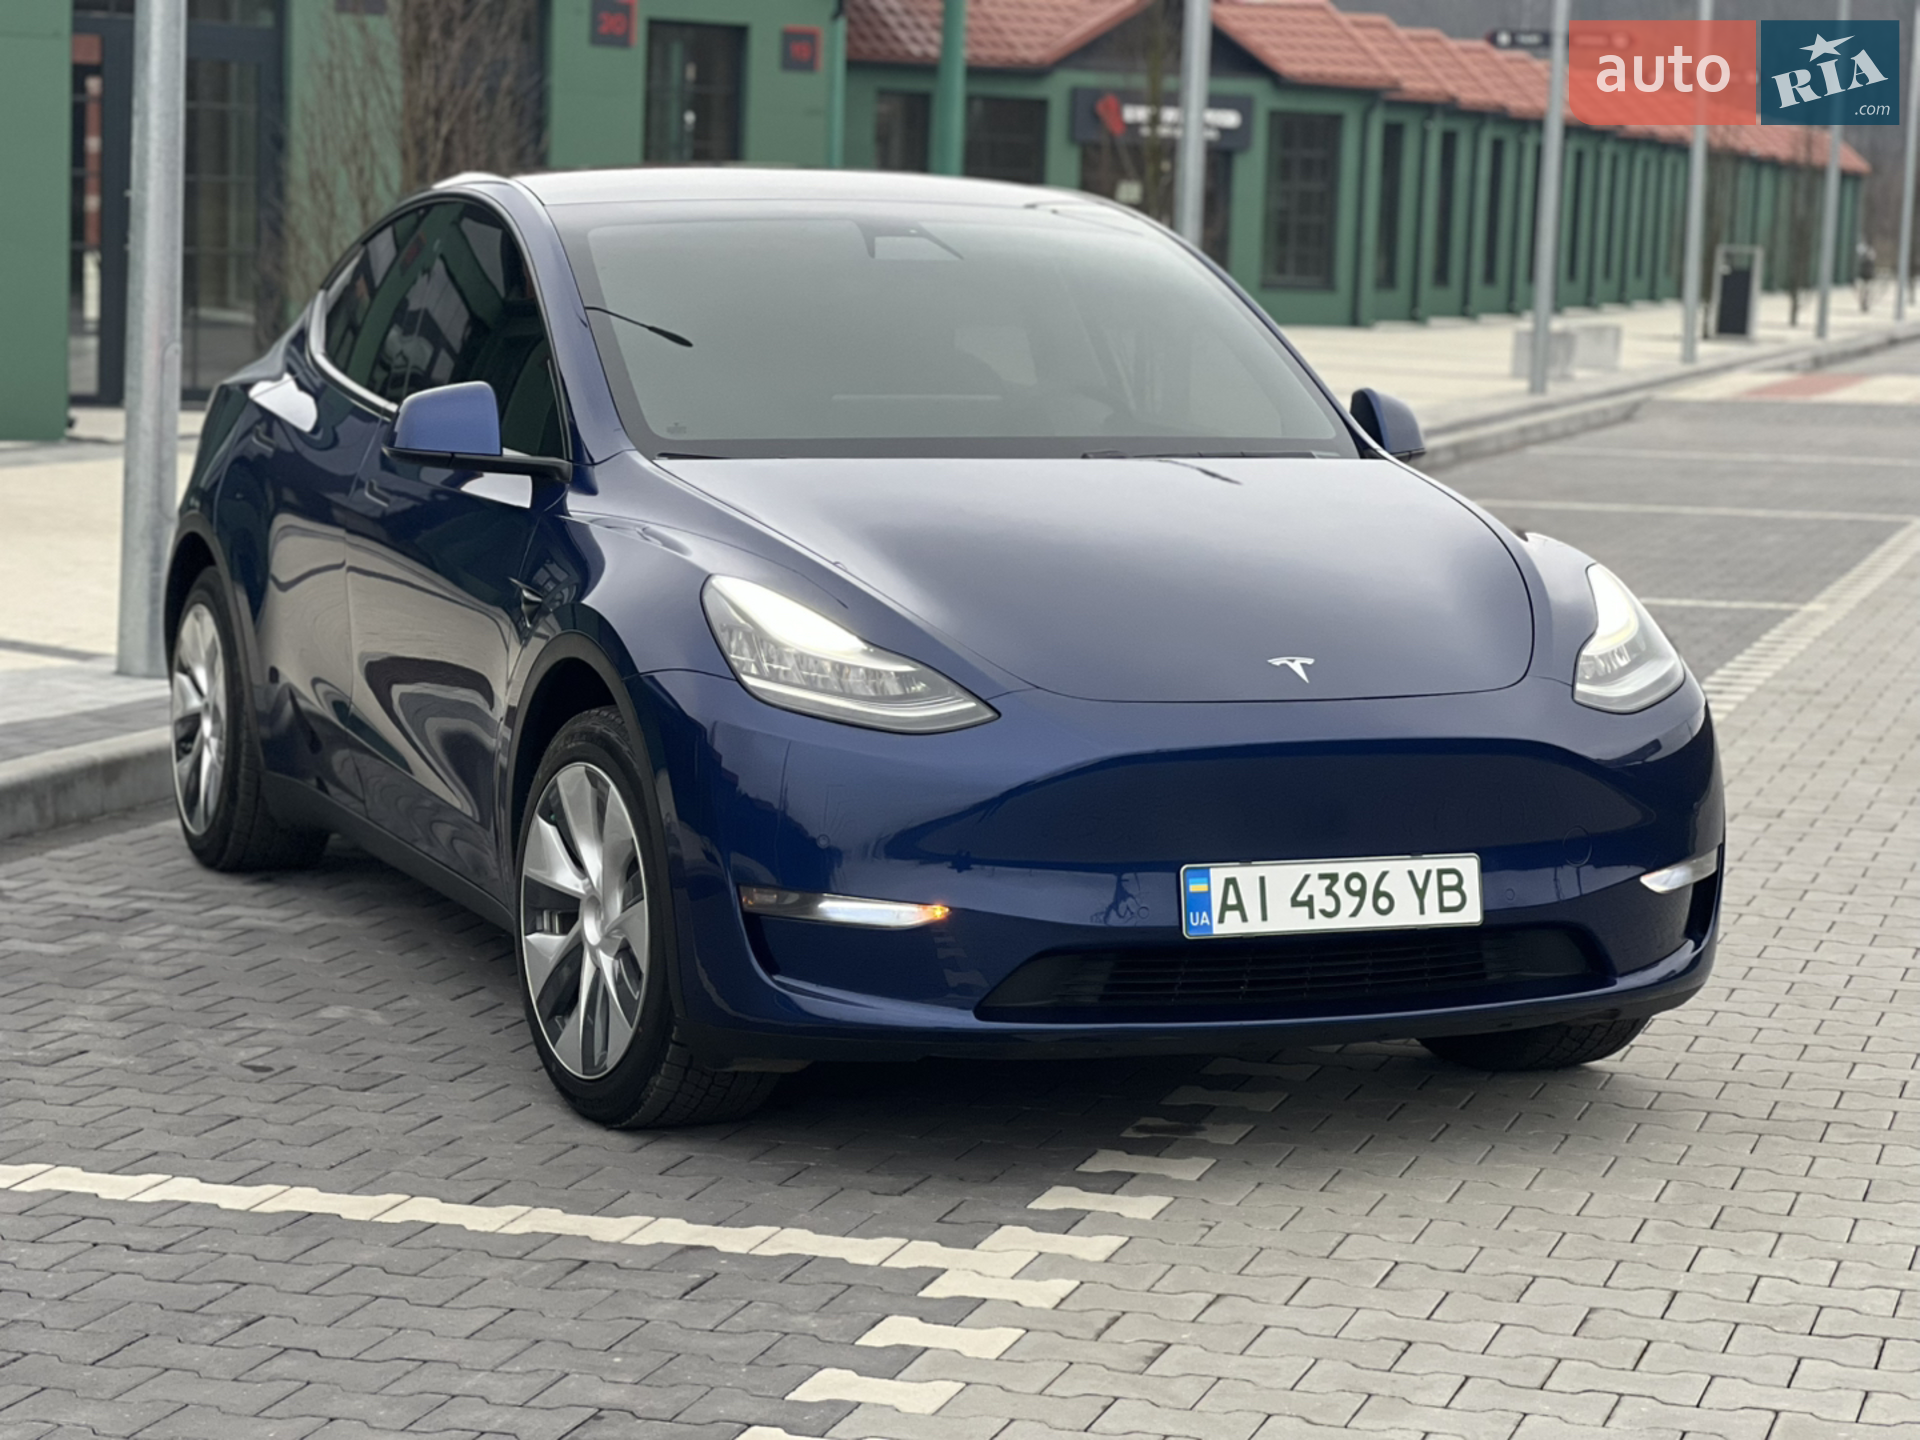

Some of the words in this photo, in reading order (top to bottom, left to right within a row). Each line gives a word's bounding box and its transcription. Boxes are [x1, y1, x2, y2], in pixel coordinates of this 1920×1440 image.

[1217, 876, 1268, 924] AI
[1290, 870, 1395, 920] 4396
[1407, 868, 1467, 916] YB
[1190, 912, 1210, 926] UA
